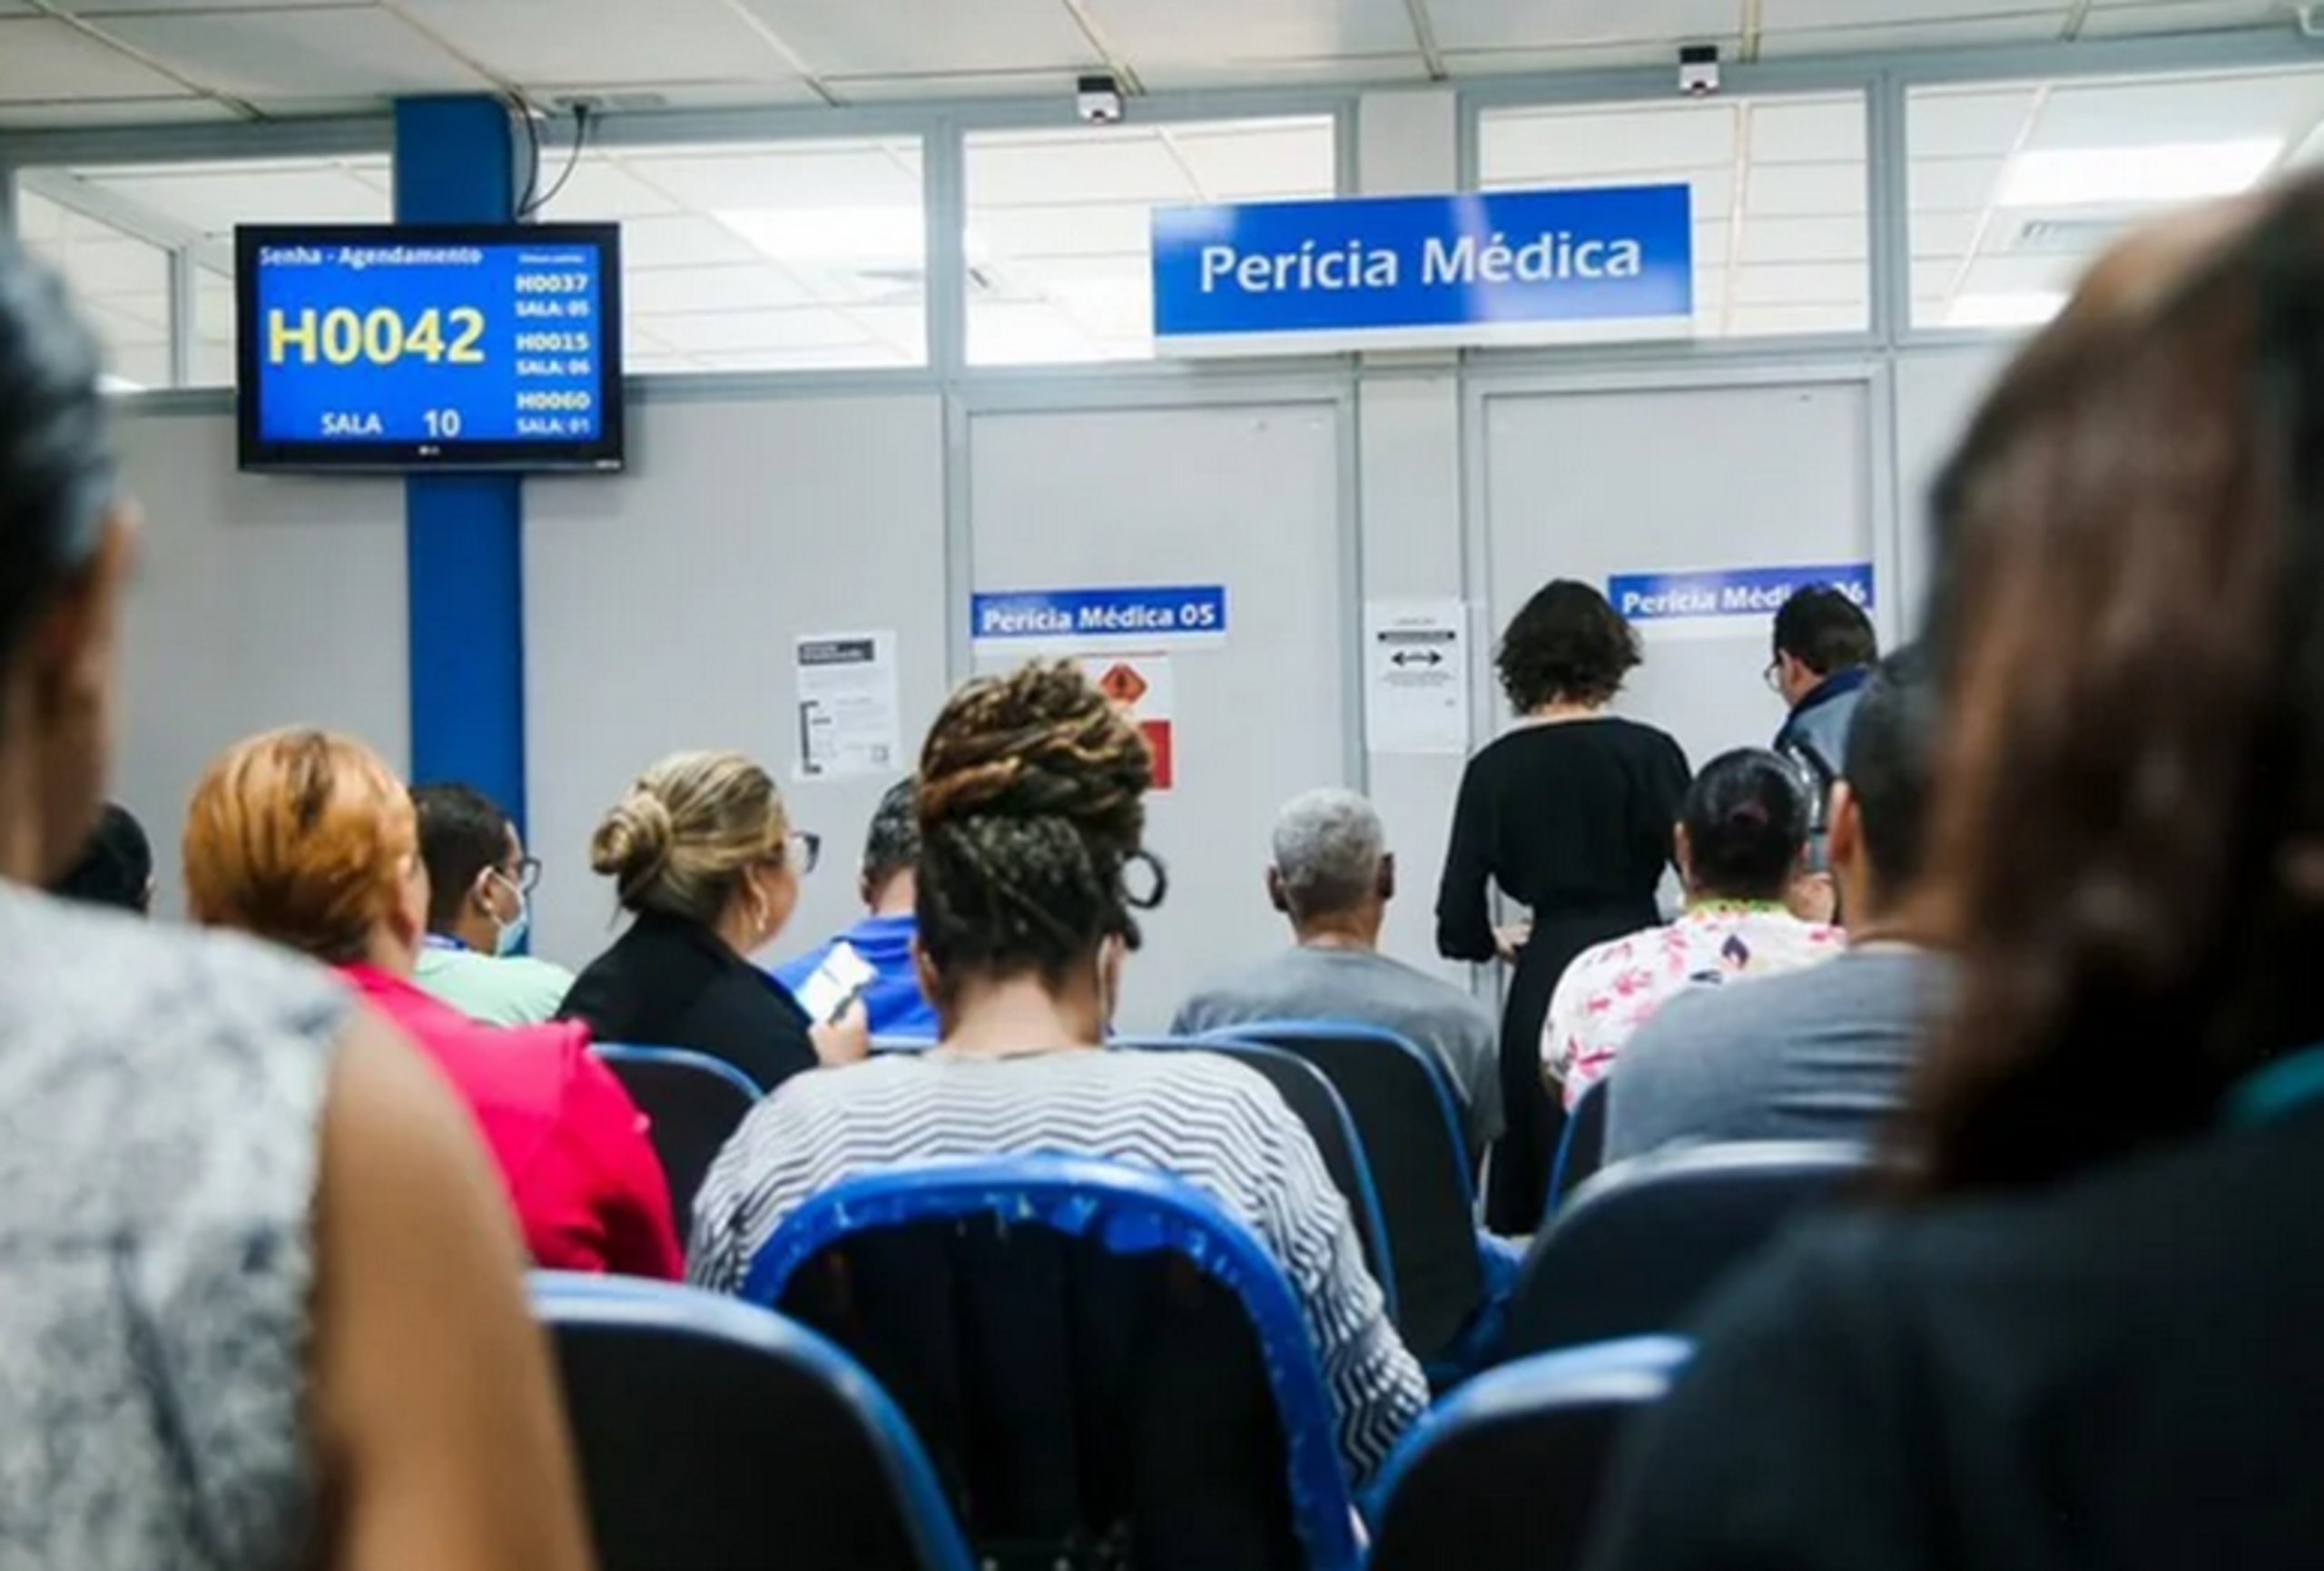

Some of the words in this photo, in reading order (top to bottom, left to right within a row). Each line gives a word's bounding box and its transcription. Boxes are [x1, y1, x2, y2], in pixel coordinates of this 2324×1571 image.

[260, 246, 321, 265] Senha
[339, 246, 483, 271] Agendamento
[1199, 240, 1398, 293] Perícia
[1421, 230, 1642, 285] Médica
[269, 307, 486, 365] H0042
[320, 411, 383, 436] SALA
[423, 408, 460, 437] 10
[1720, 582, 1792, 610] Médi
[982, 607, 1073, 633] Perícia
[1077, 604, 1174, 629] Médica
[1179, 603, 1216, 626] 05
